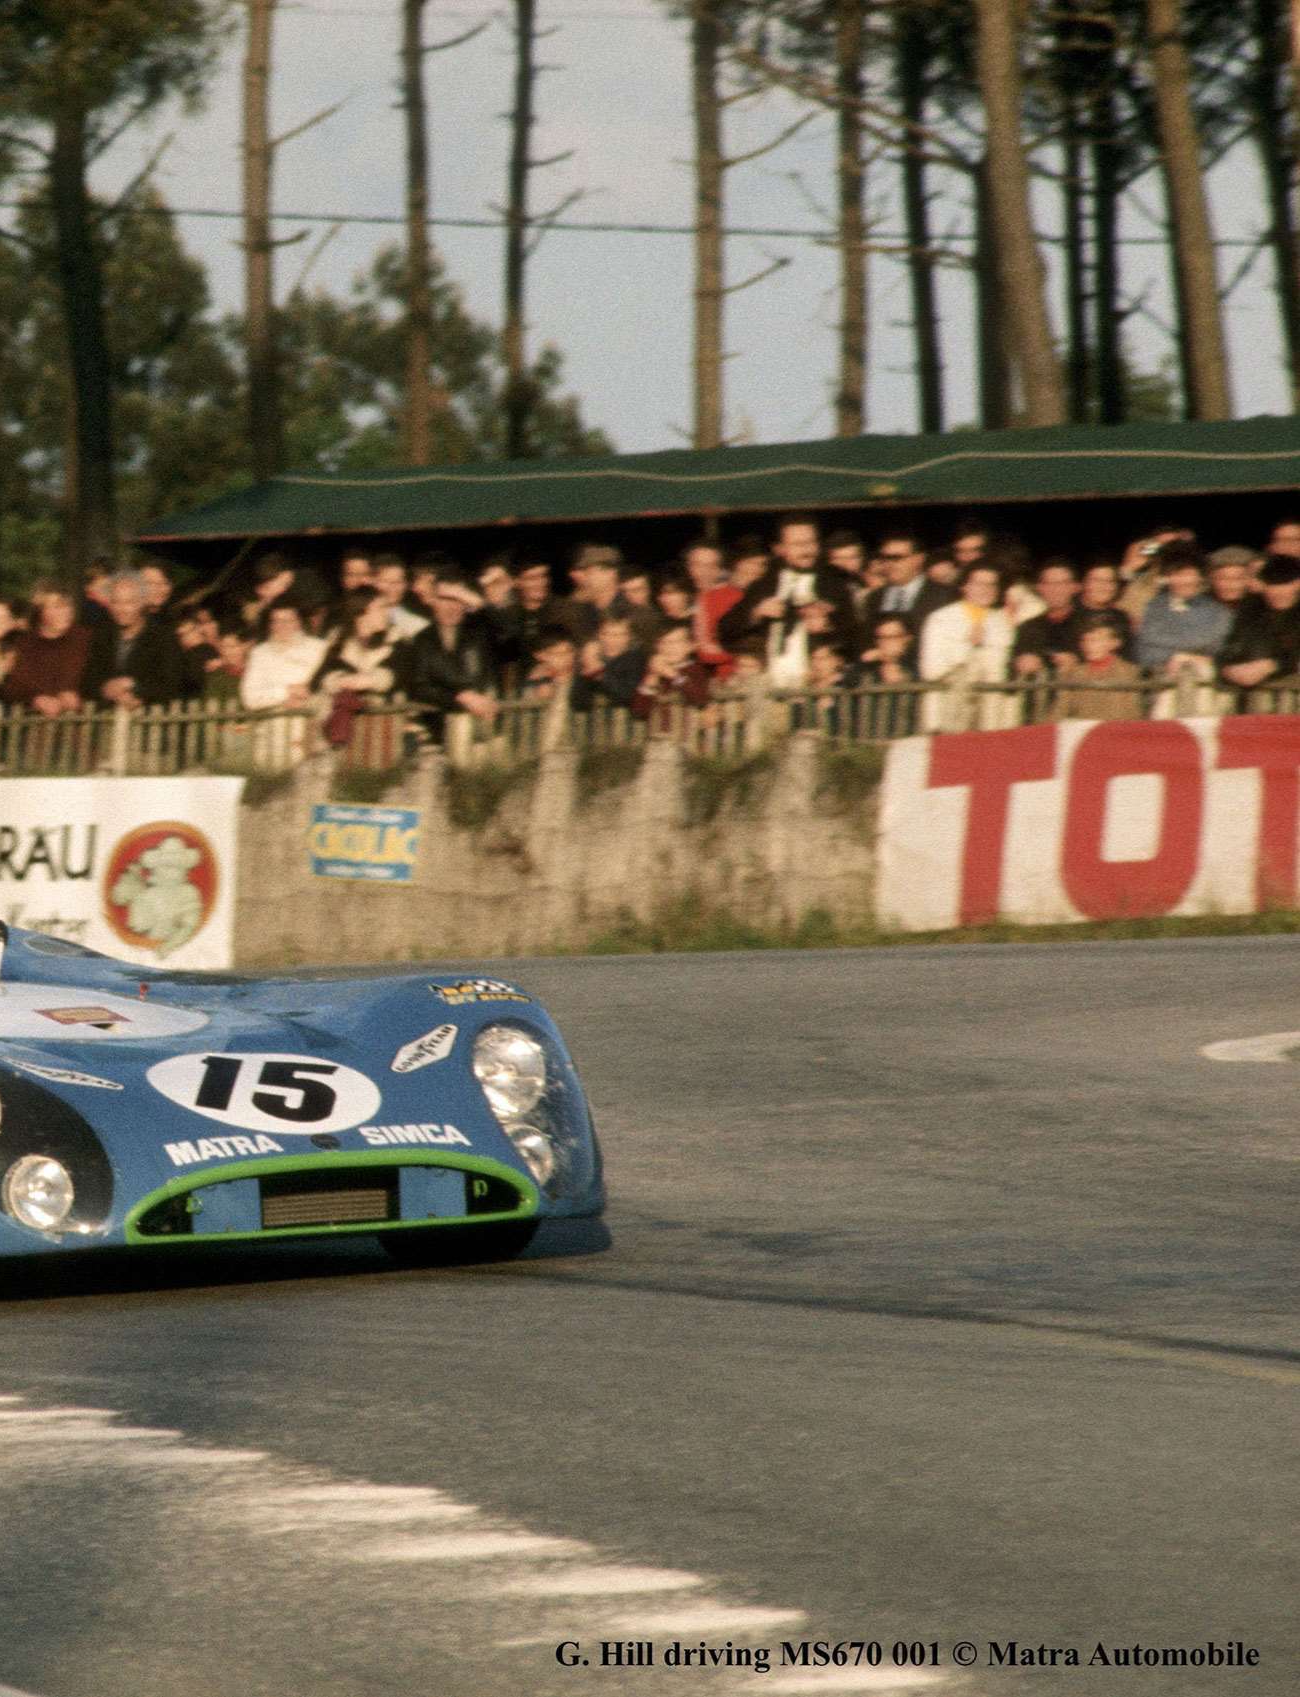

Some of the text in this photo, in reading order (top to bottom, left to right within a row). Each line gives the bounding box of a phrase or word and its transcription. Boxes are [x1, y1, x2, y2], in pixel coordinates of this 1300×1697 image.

[926, 714, 1300, 928] TOT
[195, 1055, 339, 1123] 15
[163, 1123, 473, 1167] MATRA SIMCA
